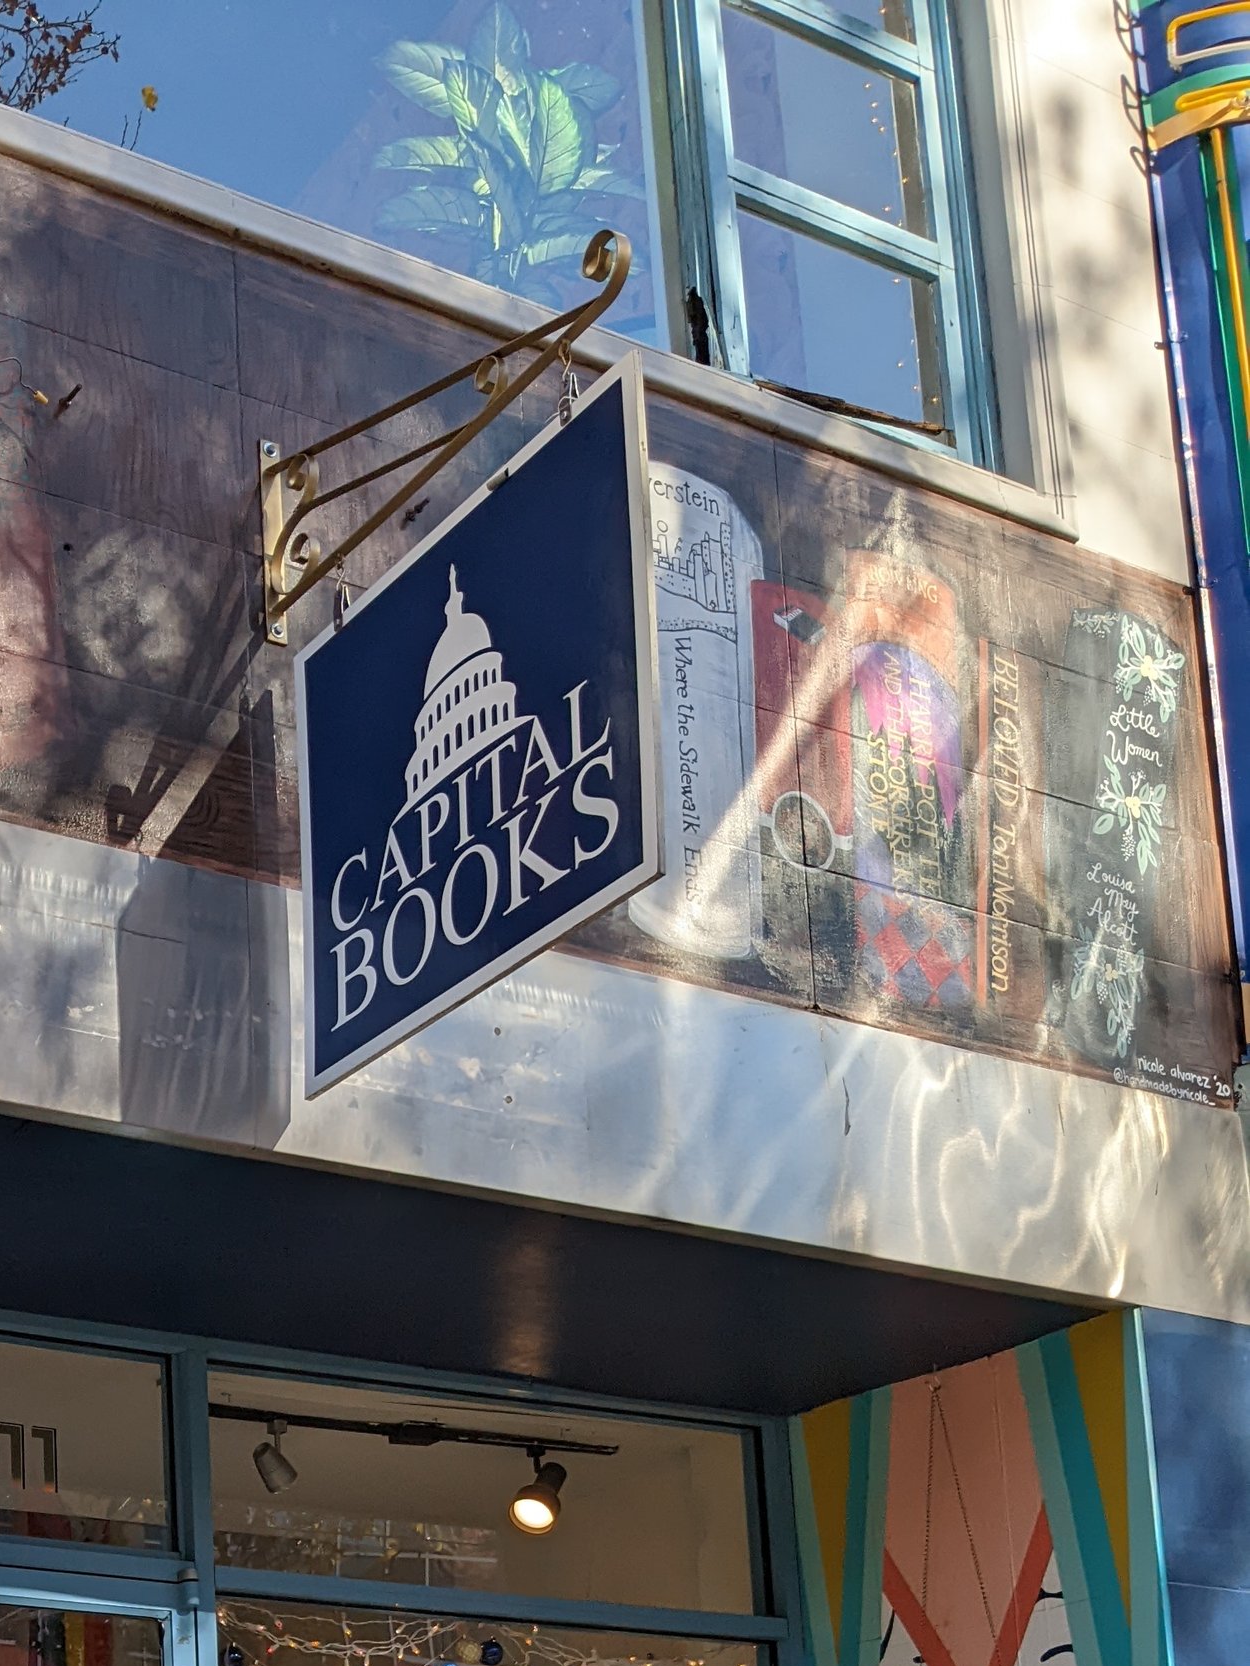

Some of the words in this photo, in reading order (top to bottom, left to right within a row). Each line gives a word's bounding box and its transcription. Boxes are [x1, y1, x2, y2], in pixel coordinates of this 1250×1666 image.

[674, 635, 693, 700] Where
[882, 651, 903, 695] AND
[676, 702, 694, 736] the
[885, 702, 908, 745] THE
[907, 675, 939, 776] HARRY
[993, 654, 1020, 807] BELOVED
[1106, 730, 1163, 767] Women
[1110, 704, 1160, 738] Little
[331, 680, 610, 932] CAPITAL
[678, 739, 701, 834] Sidewalk
[866, 730, 892, 839] STONE
[683, 846, 703, 905] Ends
[994, 818, 1018, 877] Toni
[330, 747, 619, 1033] BOOKS
[1087, 862, 1135, 894] Louisa
[1104, 887, 1139, 917] May
[991, 878, 1019, 993] Morrison
[1087, 897, 1139, 946] Alcott
[1137, 1055, 1166, 1076] nicole
[1170, 1063, 1212, 1089] alvarez
